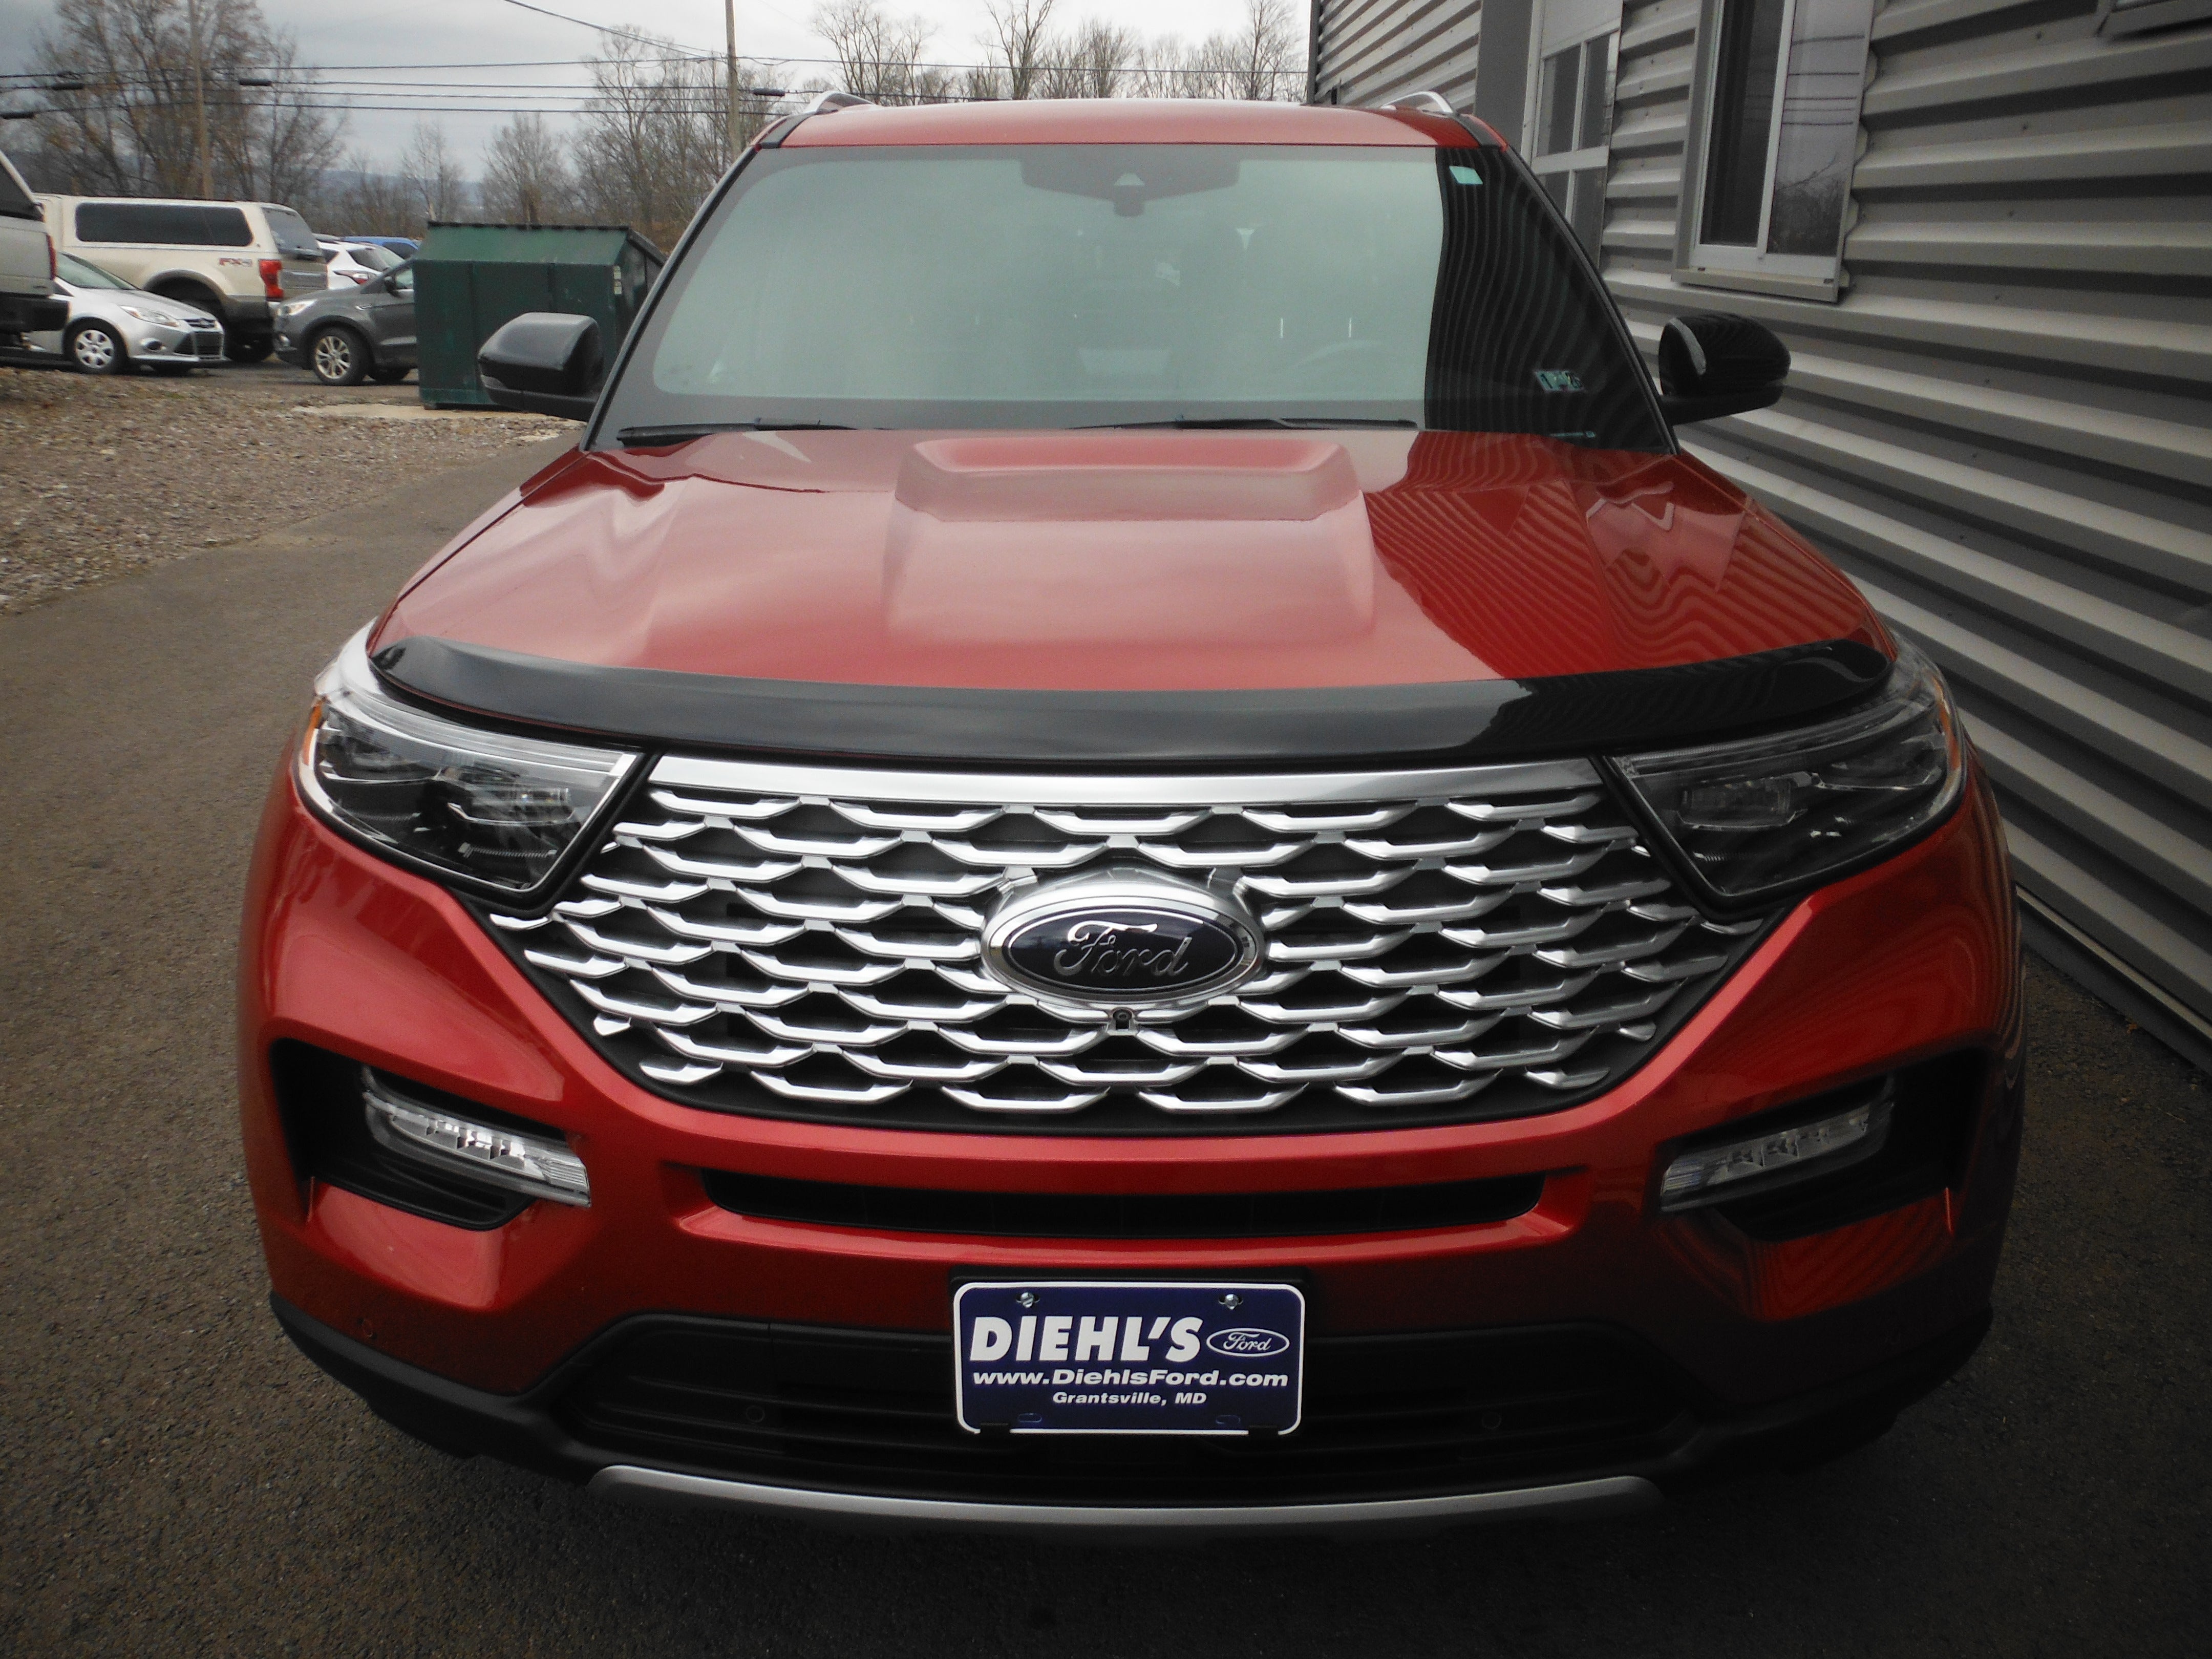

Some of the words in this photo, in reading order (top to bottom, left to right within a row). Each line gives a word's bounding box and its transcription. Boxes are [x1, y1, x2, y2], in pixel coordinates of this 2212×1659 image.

[1054, 920, 1192, 975] Ford
[969, 1315, 1203, 1363] DIEHL'S
[1223, 1332, 1272, 1351] Ford
[973, 1369, 1288, 1387] www.DiehlsFord.com
[1052, 1391, 1167, 1407] Grantsville,
[1174, 1392, 1207, 1405] MD
